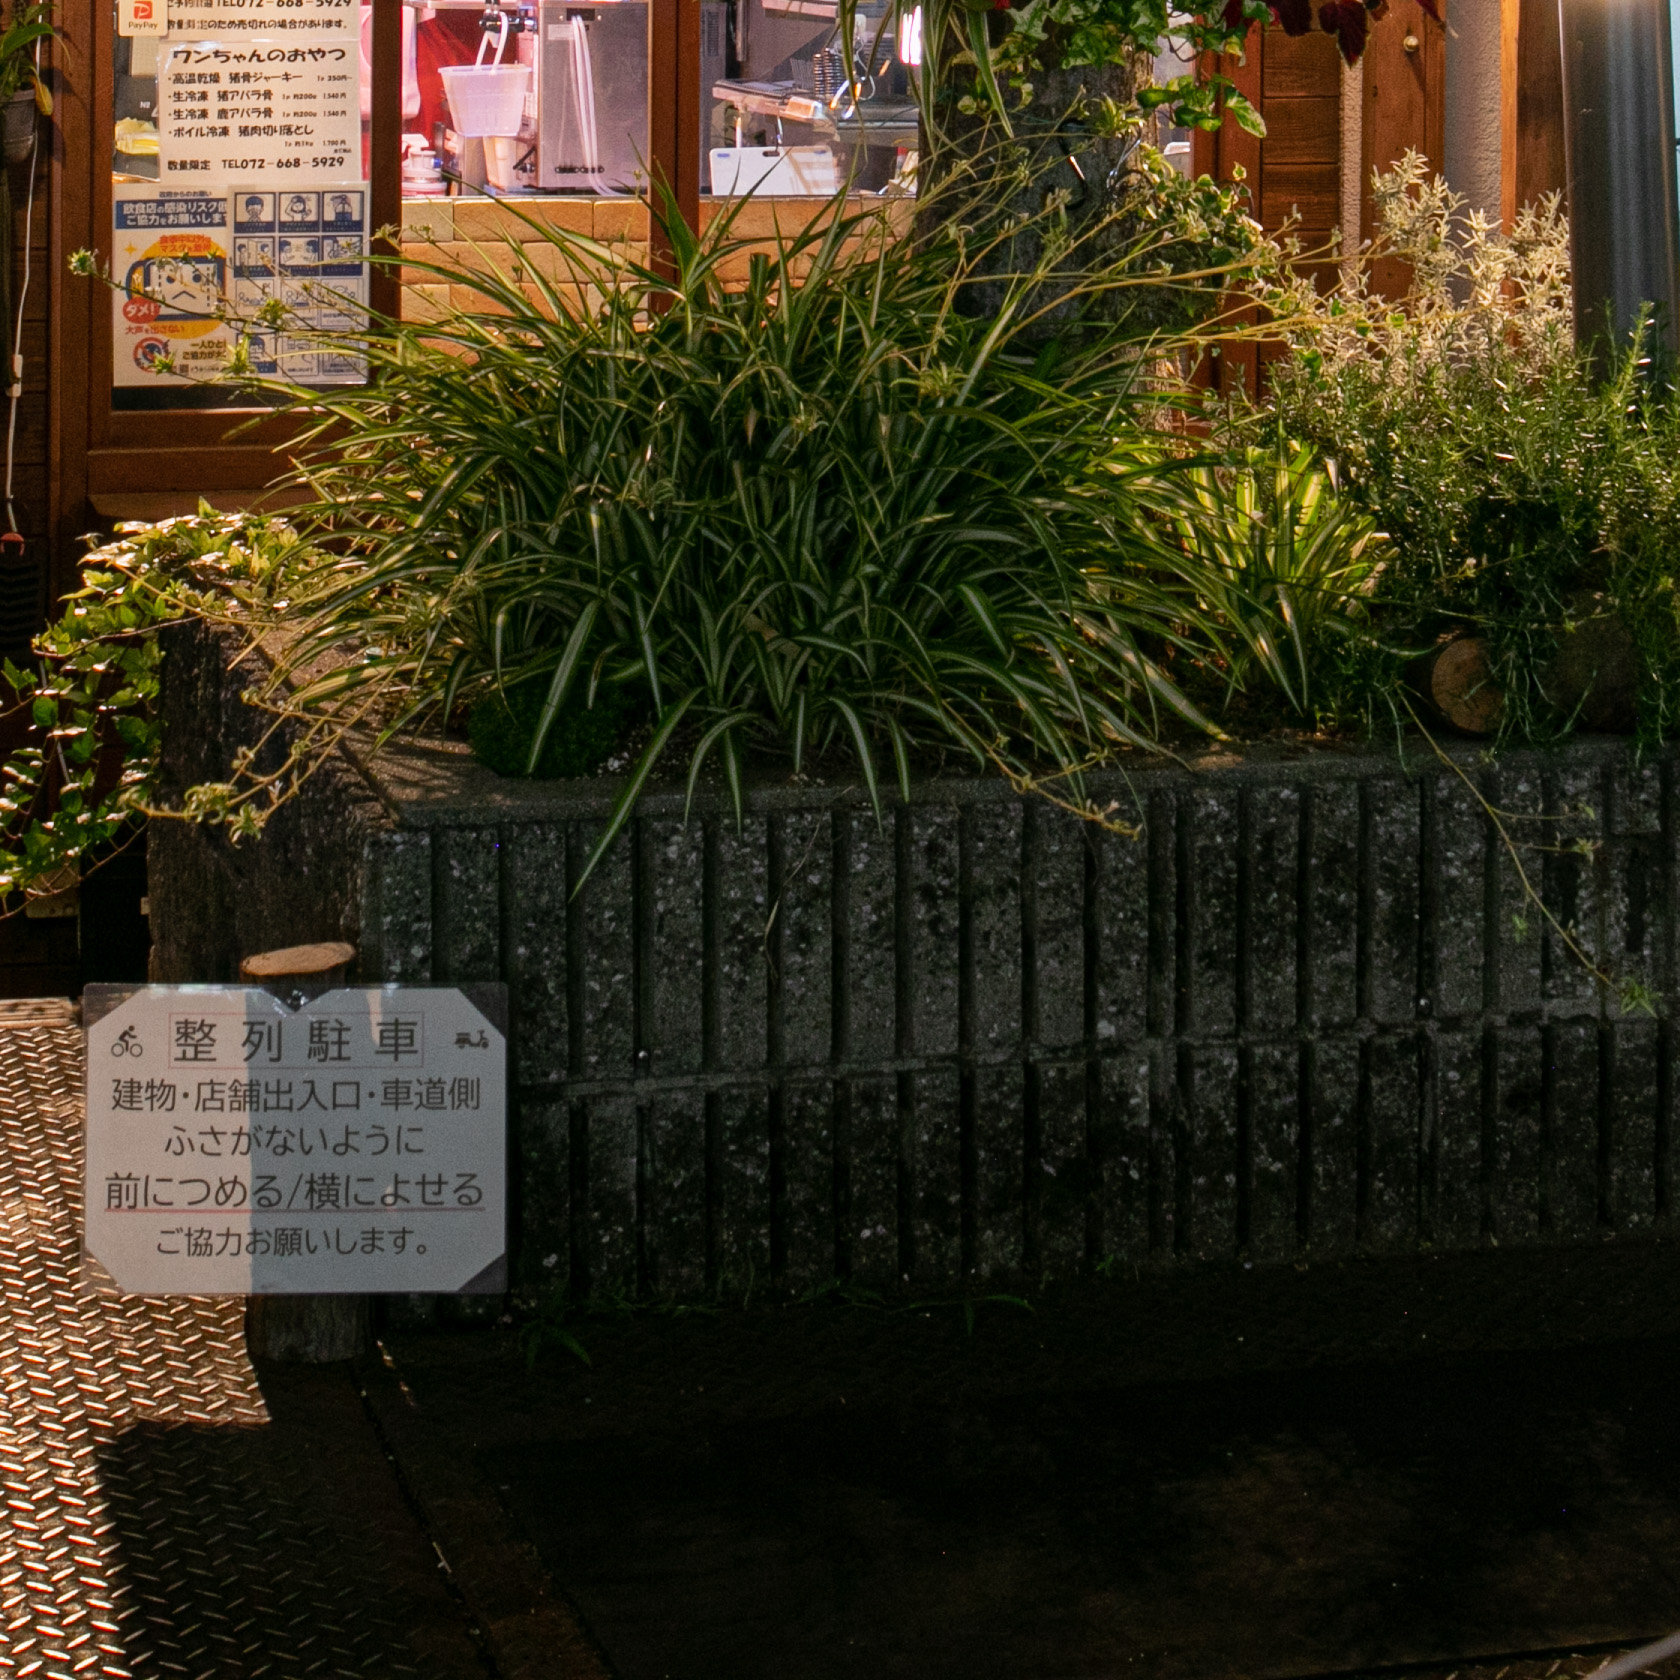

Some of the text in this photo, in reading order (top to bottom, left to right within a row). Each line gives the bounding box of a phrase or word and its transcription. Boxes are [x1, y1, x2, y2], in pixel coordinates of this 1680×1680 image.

[128, 22, 158, 30] PayPay
[172, 48, 346, 64] ワンちゃんのおやつ
[168, 160, 211, 170] 数量限定
[173, 1018, 419, 1063] 整列駐車
[111, 1076, 482, 1113] 建物・店舗出入口・車道側
[164, 1125, 426, 1157] ふさがないように
[105, 1171, 484, 1210] 前につめる/横によせる
[157, 1226, 428, 1257] ご協力お願いします。
